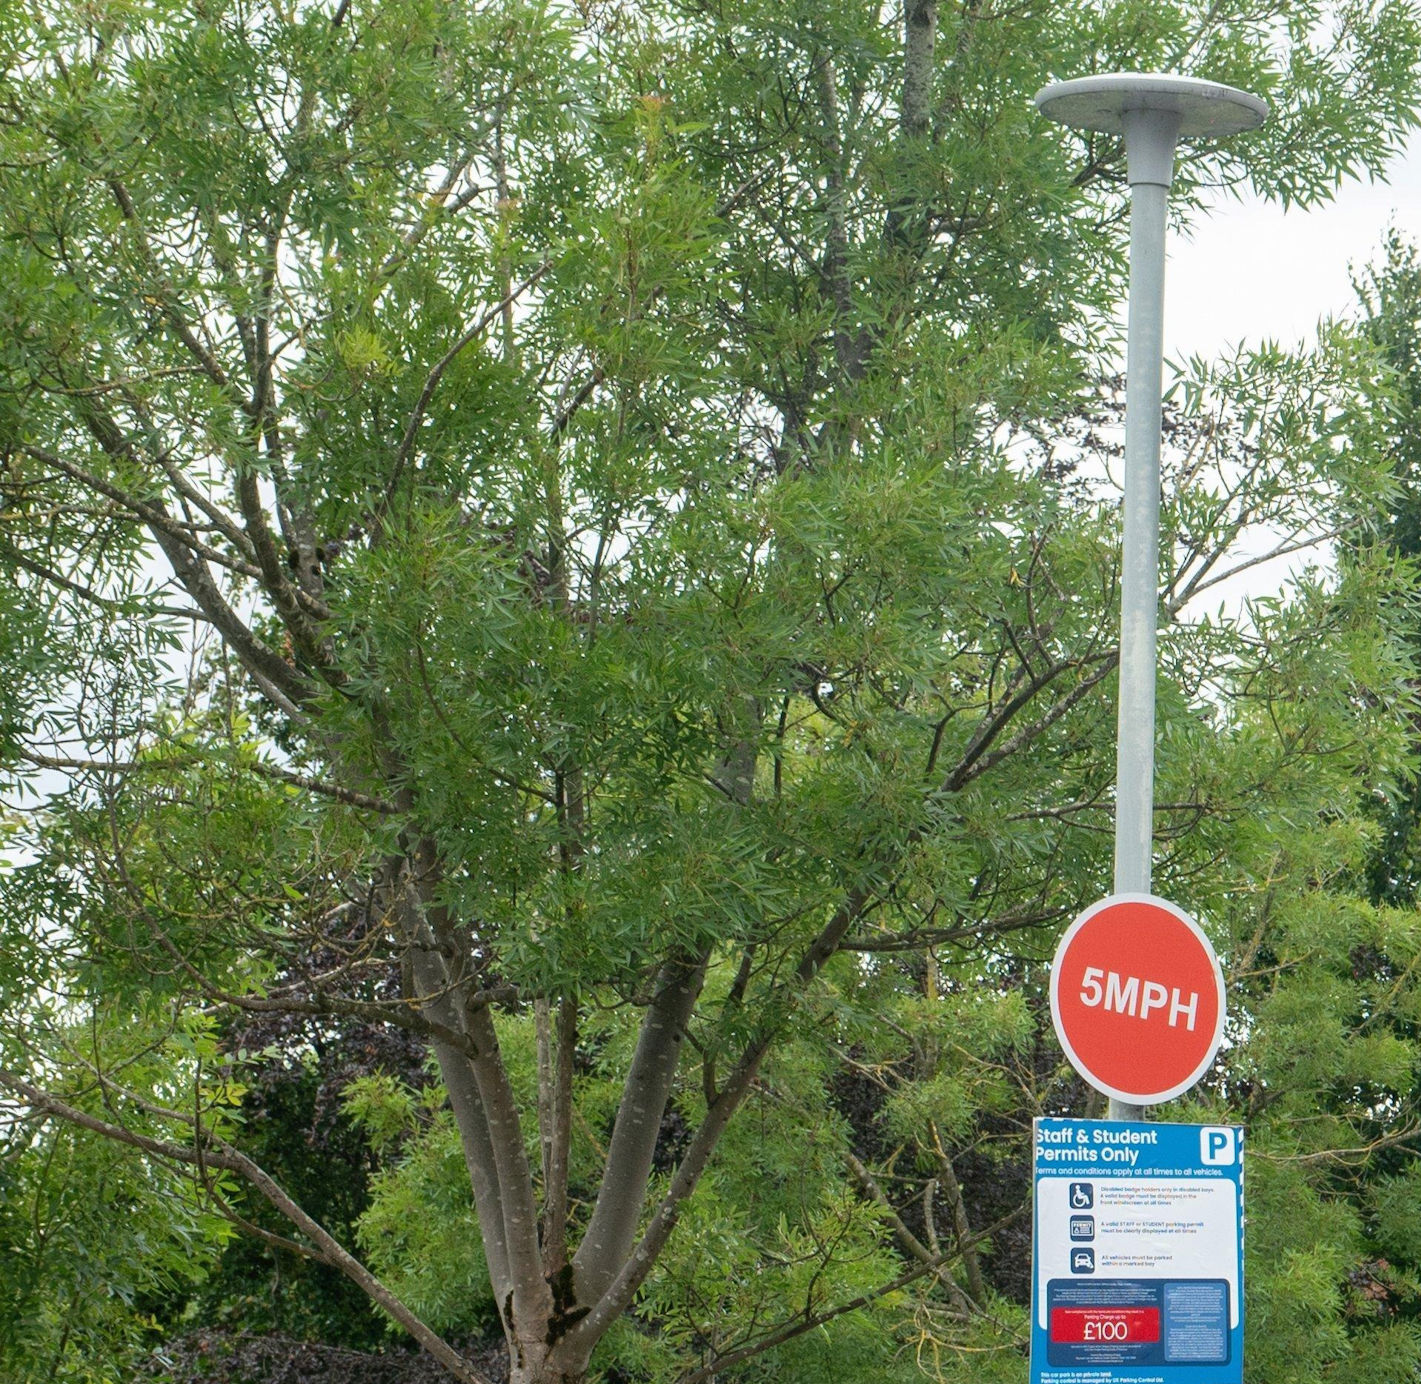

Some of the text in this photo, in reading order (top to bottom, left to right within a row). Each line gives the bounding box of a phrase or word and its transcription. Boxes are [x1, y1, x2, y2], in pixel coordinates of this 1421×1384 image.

[1080, 966, 1199, 1032] 5MPH
[1036, 1128, 1157, 1144] Staff & Student
[1208, 1132, 1228, 1160] P
[1036, 1146, 1139, 1166] Permits Only
[1058, 1167, 1073, 1175] and
[1074, 1167, 1111, 1175] conditions
[1113, 1167, 1133, 1177] apply
[1135, 1167, 1142, 1175] at
[1144, 1167, 1152, 1175] all
[1154, 1167, 1173, 1175] times
[1175, 1167, 1182, 1175] to
[1184, 1167, 1192, 1175] all
[1083, 1321, 1128, 1341] £100
